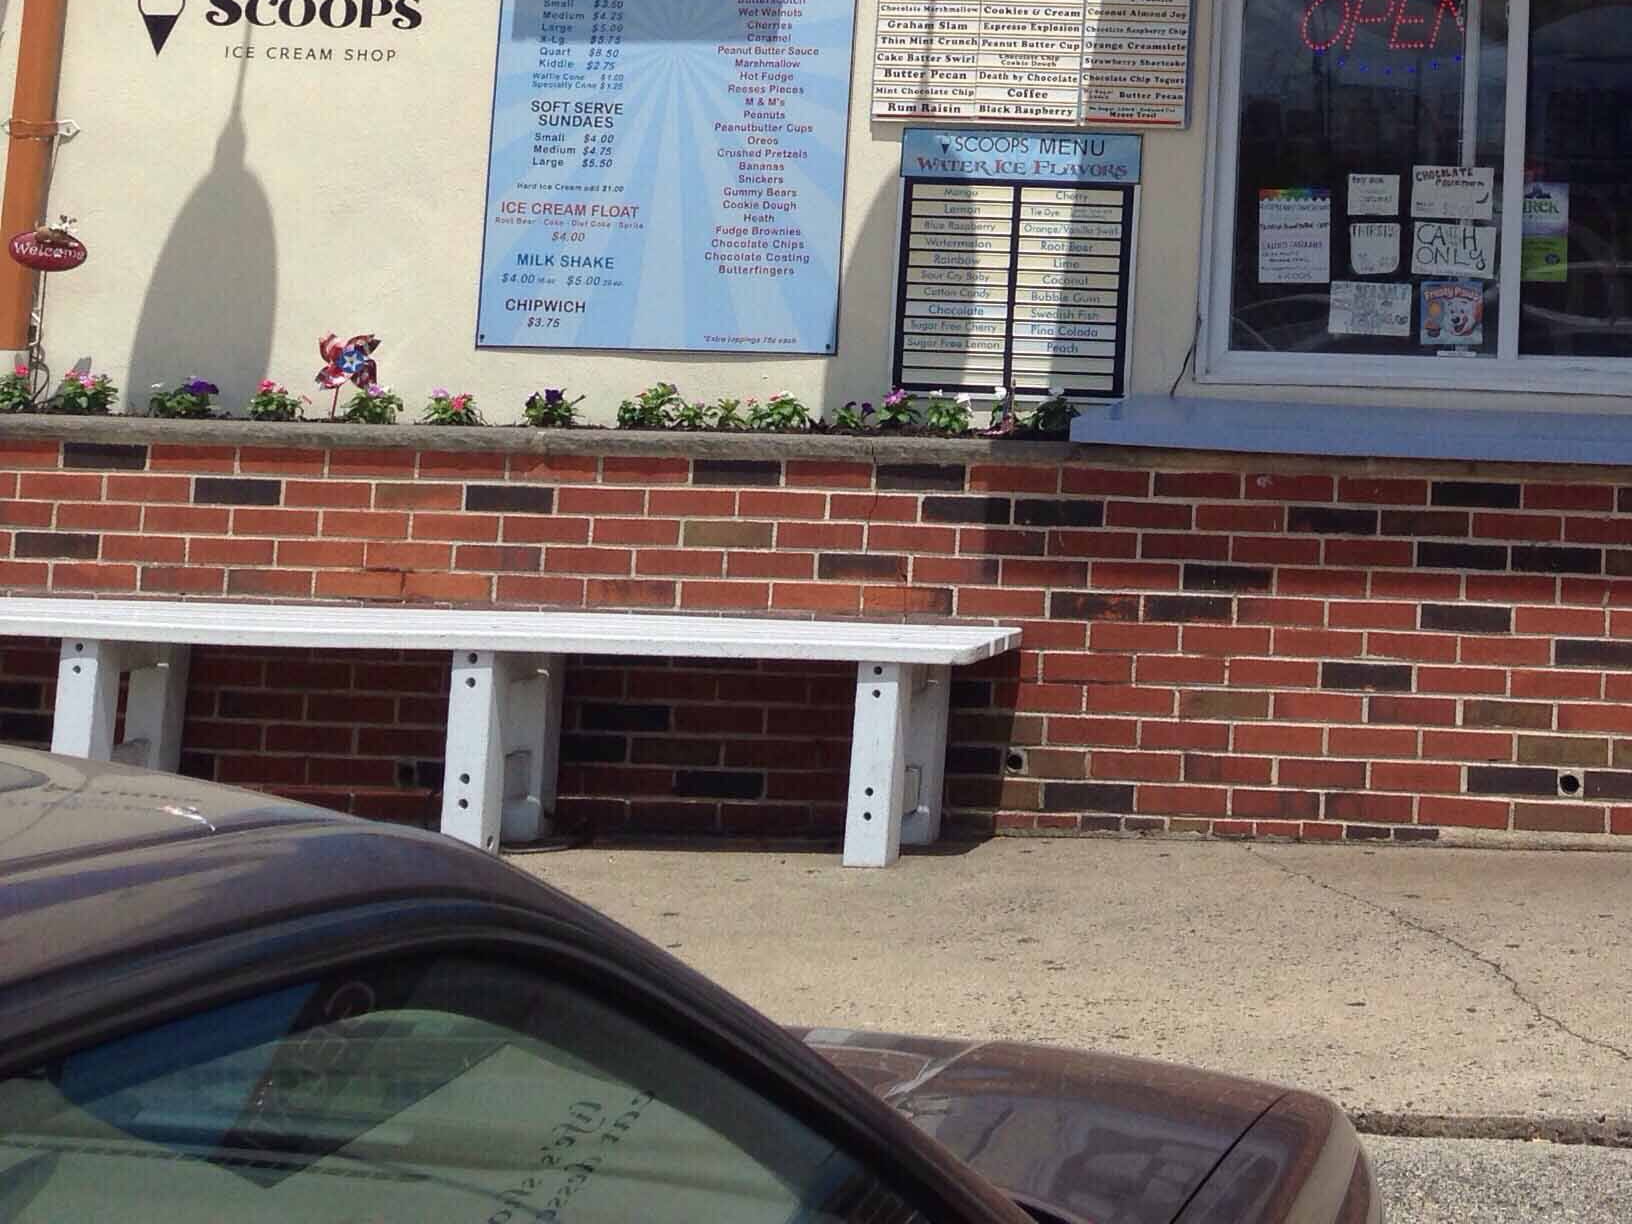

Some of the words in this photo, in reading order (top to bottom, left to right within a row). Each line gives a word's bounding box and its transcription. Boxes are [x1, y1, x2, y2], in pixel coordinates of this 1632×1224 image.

[738, 7, 759, 17] Wet
[761, 7, 804, 18] Walnuts
[983, 6, 1028, 16] Cookies
[1044, 8, 1081, 18] Cream
[224, 45, 256, 60] ICE
[266, 46, 334, 62] CREAM
[344, 48, 398, 63] SHOP
[718, 46, 752, 56] Peanut
[754, 46, 786, 56] Butter
[788, 47, 820, 57] Sauce
[735, 58, 801, 69] Marshmallow
[739, 71, 759, 81] Hot
[761, 71, 795, 83] Fudge
[884, 68, 927, 80] Butter
[930, 69, 968, 81] Pecan
[1007, 88, 1049, 99] Coffee
[530, 100, 571, 113] SOFT
[574, 101, 624, 116] SERVE
[888, 102, 917, 113] Rum
[979, 104, 1011, 115] Black
[1015, 105, 1074, 117] Raspberry
[743, 110, 786, 120] Peanuts
[538, 114, 614, 129] SUNDAES
[786, 123, 814, 135] Cups
[534, 132, 565, 142] Small
[583, 133, 615, 145] $4.00
[747, 136, 779, 146] Oreos
[533, 144, 576, 155] Medium
[582, 145, 613, 156] $4.75
[955, 136, 1029, 154] SCOOPS
[1039, 137, 1106, 157] MENU
[532, 157, 565, 169] Large
[581, 158, 613, 169] $5.50
[738, 161, 785, 171] Bananas
[916, 156, 995, 176] WATER
[993, 158, 1026, 177] ICE
[1032, 159, 1129, 180] FLAVORS
[738, 174, 784, 185] Snickers
[723, 187, 763, 199] Gummy
[766, 187, 798, 198] Bears
[501, 201, 527, 215] ICE
[531, 202, 587, 217] CREAM
[591, 204, 641, 219] FLOAT
[722, 200, 760, 210] Cookie
[762, 201, 797, 213] Dough
[743, 213, 775, 223] Heath
[551, 231, 586, 243] $4.00
[715, 226, 749, 238] Fudge
[751, 226, 801, 237] Brownies
[711, 239, 769, 249] Chocolate
[772, 239, 805, 251] Chips
[516, 253, 555, 267] MILK
[560, 254, 615, 270] SHAKE
[704, 251, 762, 262] Chocolate
[718, 265, 795, 277] Butterfingers
[501, 272, 536, 285] $4.00
[566, 274, 601, 287] $5.00
[505, 298, 587, 313] CHIPWICH
[928, 303, 985, 316] Chocolate
[527, 316, 561, 328] $3.75
